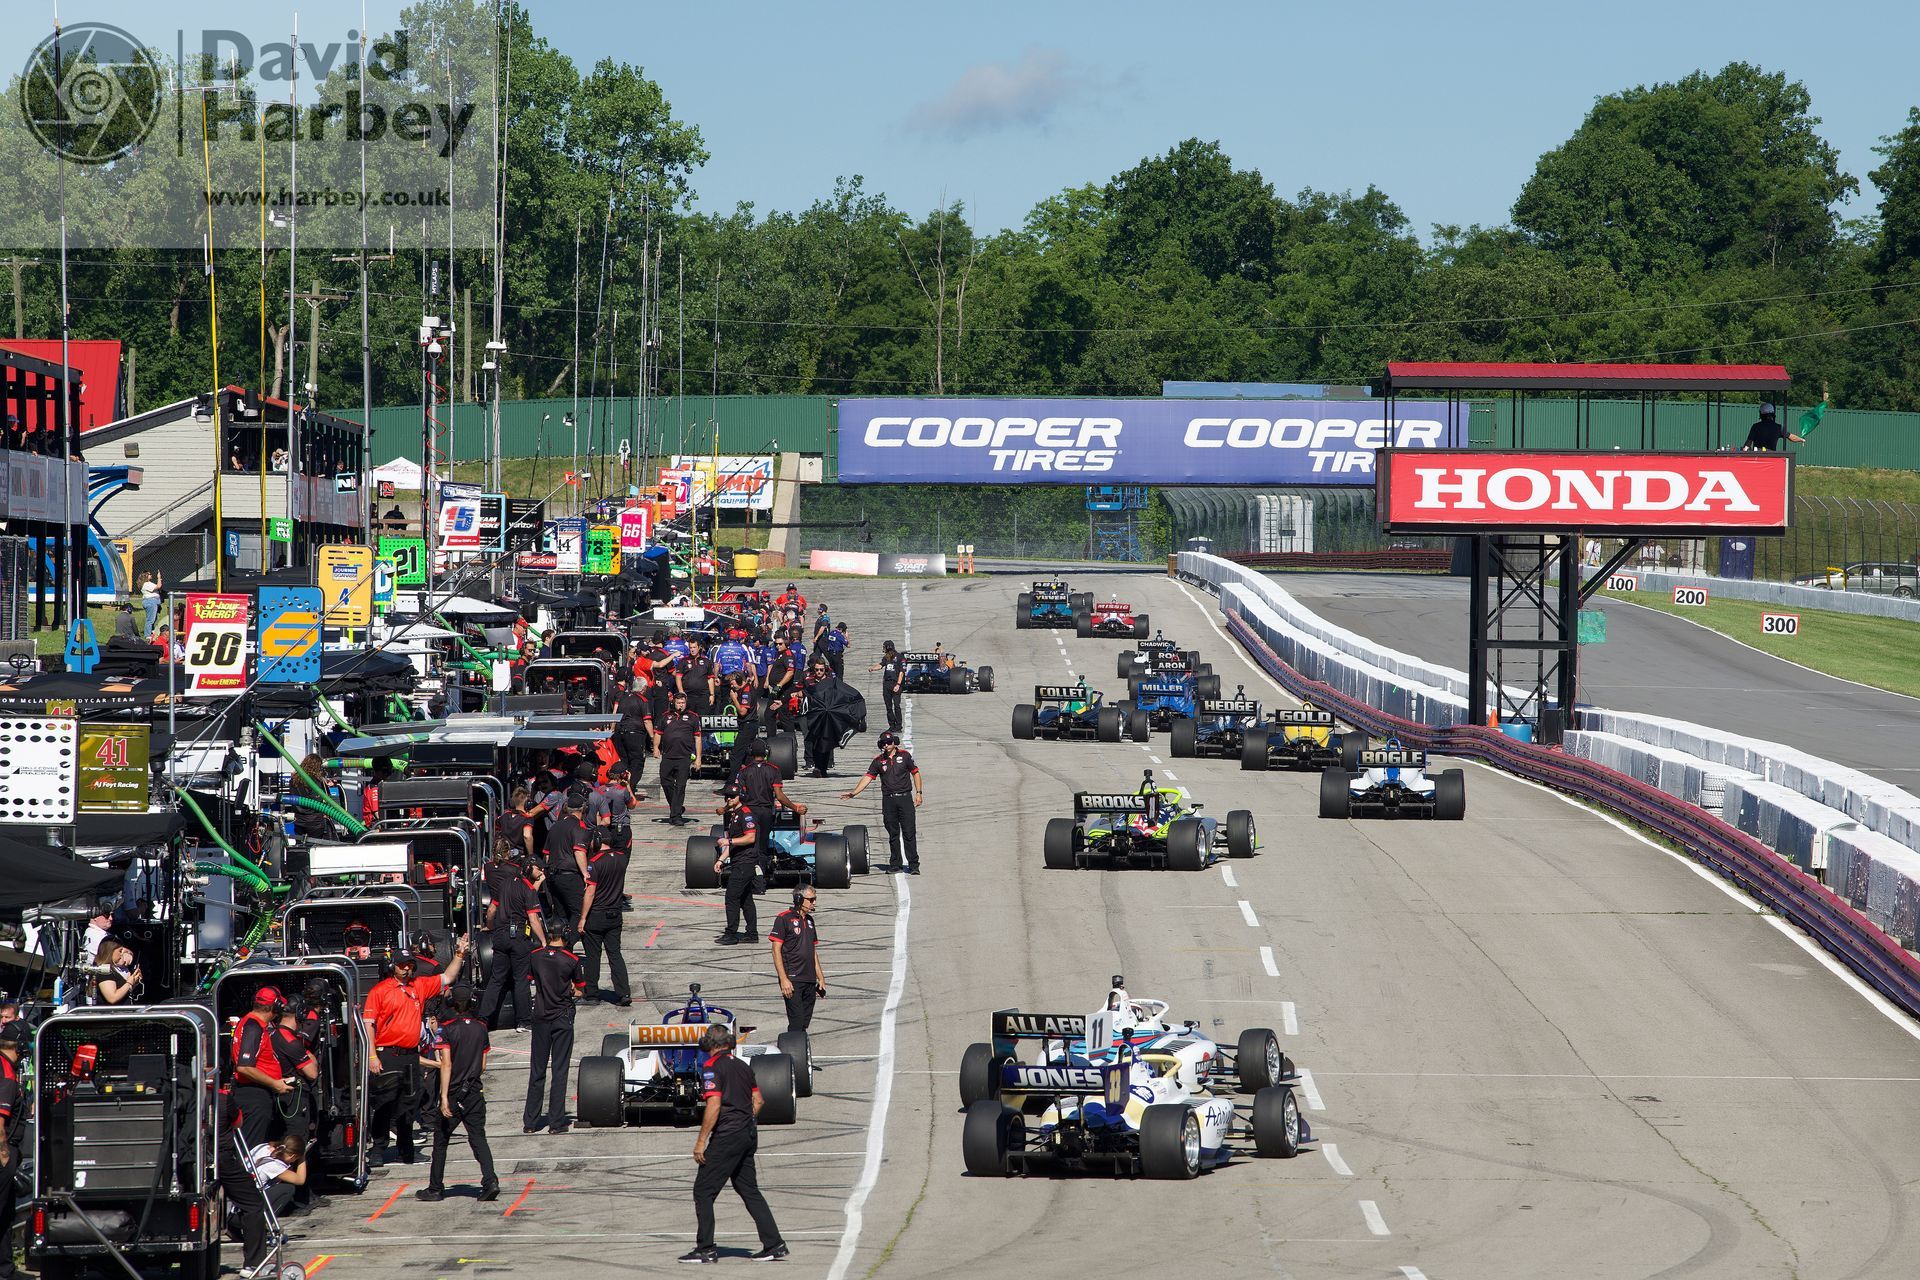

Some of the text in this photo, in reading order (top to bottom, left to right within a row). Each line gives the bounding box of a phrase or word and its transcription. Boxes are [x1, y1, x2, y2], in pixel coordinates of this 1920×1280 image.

[864, 417, 1123, 449] COOPER
[1184, 418, 1443, 449] COOPER
[988, 449, 1118, 472] TIRES
[1308, 450, 1377, 473] TIR
[1414, 467, 1760, 512] HONDA
[445, 506, 475, 531] 15
[622, 523, 641, 538] 66
[392, 546, 418, 577] 21
[520, 556, 556, 565] ERICSSON
[1608, 576, 1635, 592] 100
[205, 597, 240, 610] 5-hour
[1675, 590, 1705, 606] 200
[200, 609, 238, 620] ENERGY
[1764, 616, 1797, 634] 300
[190, 631, 243, 667] 30
[904, 653, 939, 661] FOSTER
[1040, 687, 1084, 697] COLLET
[1142, 684, 1183, 692] MILLER
[1204, 700, 1254, 712] HEDGE
[1279, 710, 1331, 723] GOLD
[96, 737, 129, 767] 41
[1361, 751, 1422, 765] BOGLE
[117, 781, 139, 789] Racing
[1081, 795, 1146, 808] BROOKS
[1006, 1016, 1085, 1034] ALLAER
[1092, 1018, 1104, 1049] 11
[1013, 1068, 1104, 1087] JONES
[74, 1171, 87, 1188] 3
